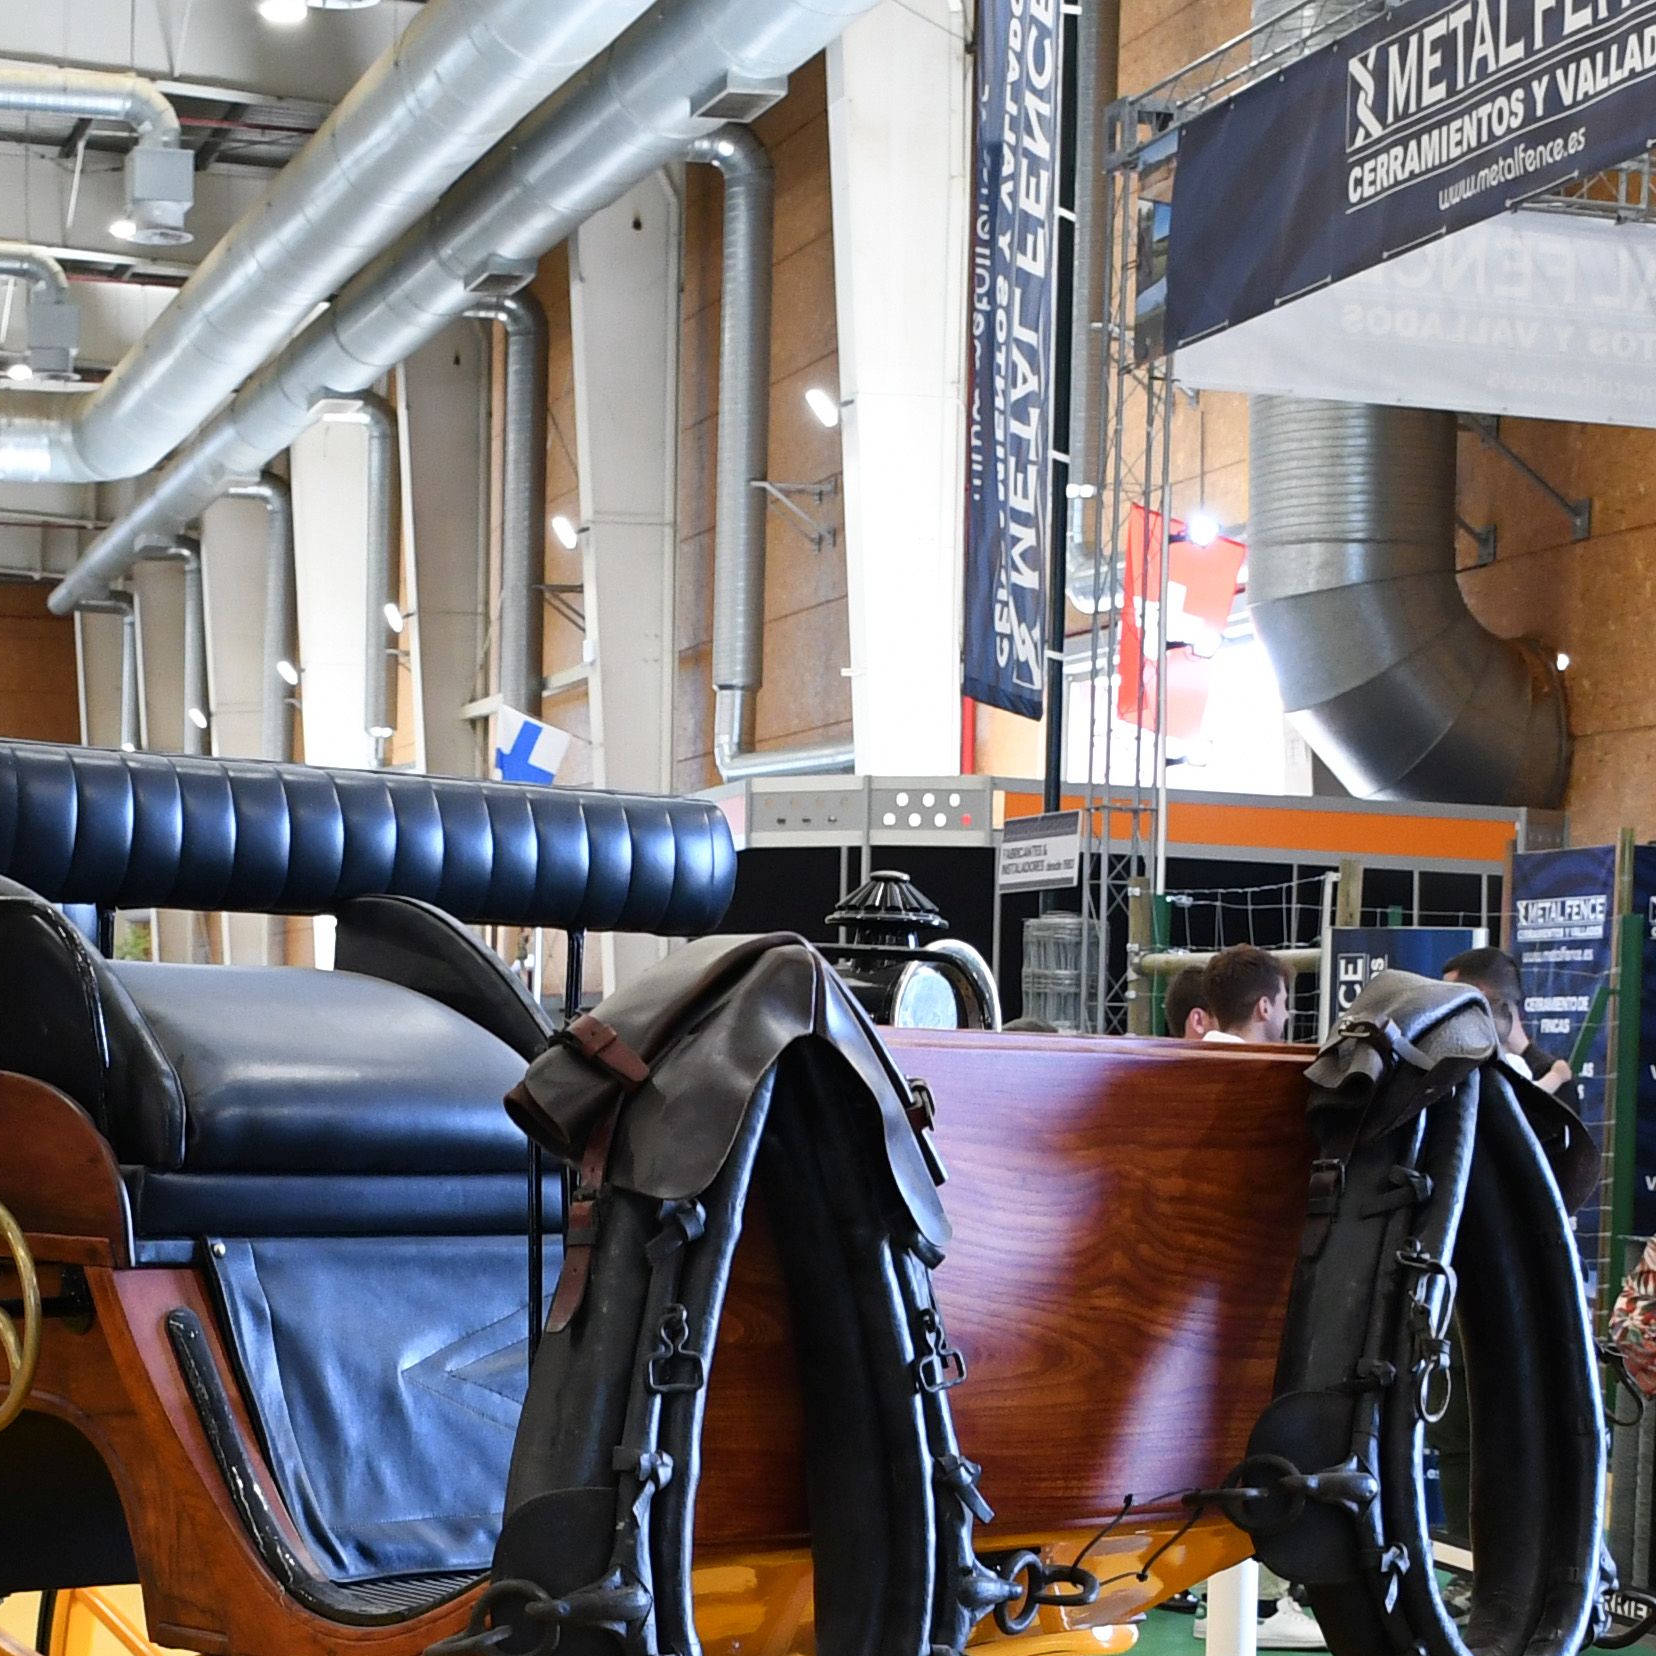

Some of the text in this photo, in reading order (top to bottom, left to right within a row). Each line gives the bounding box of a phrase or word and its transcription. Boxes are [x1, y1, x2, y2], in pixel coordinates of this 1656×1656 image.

[1386, 0, 1525, 125] METAL
[1348, 88, 1525, 204] CERRAMIENTOS
[1531, 75, 1552, 118] Y
[1438, 127, 1586, 211] www.metalfence.es
[1527, 897, 1606, 924] METAL FENCE
